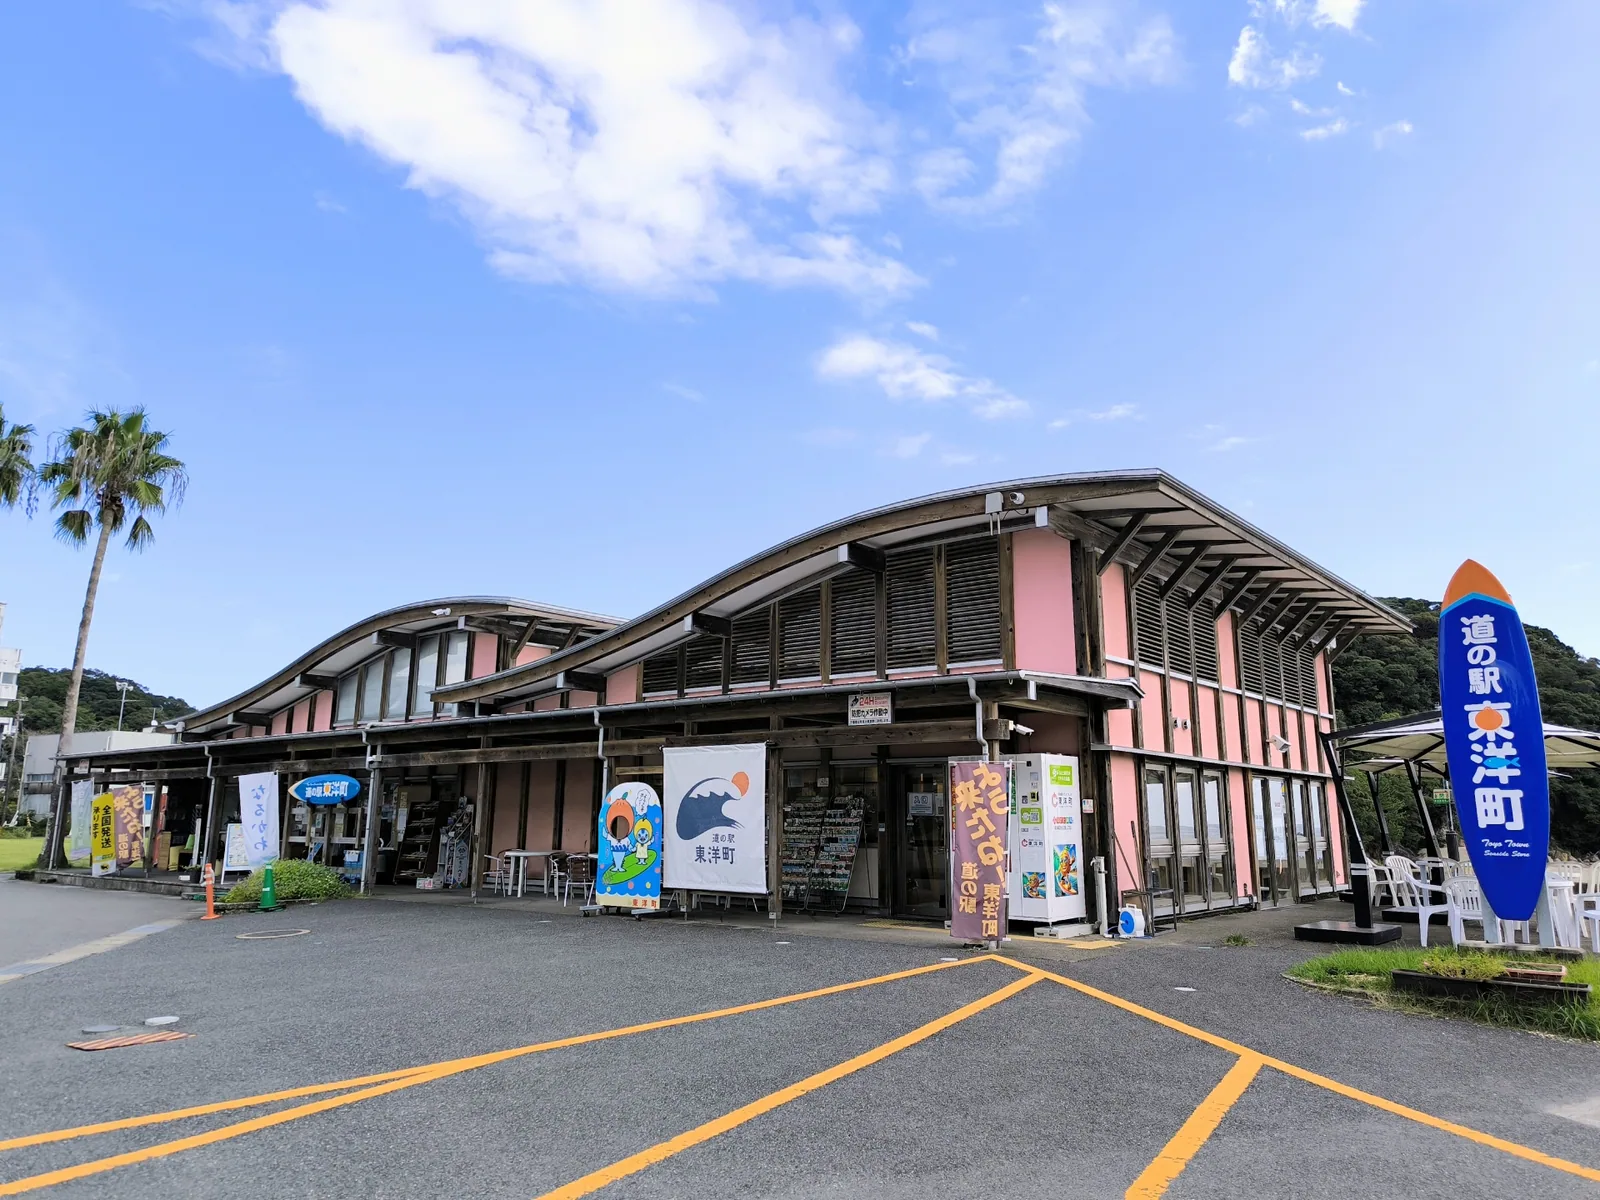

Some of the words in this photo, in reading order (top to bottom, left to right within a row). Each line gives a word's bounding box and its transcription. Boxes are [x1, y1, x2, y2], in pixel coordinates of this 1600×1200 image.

[1460, 614, 1503, 695] 道の駅
[859, 696, 875, 706] 24H
[1464, 700, 1525, 831] 東洋町
[305, 787, 322, 797] 道の駅
[323, 781, 349, 797] 東洋町
[101, 805, 112, 849] 全国発送
[712, 833, 736, 844] 道の駅
[1481, 838, 1503, 849] Toyo
[1504, 839, 1530, 848] Town
[694, 845, 736, 865] 東洋町
[1484, 849, 1509, 857] Seaside
[632, 898, 658, 908] 東洋町
